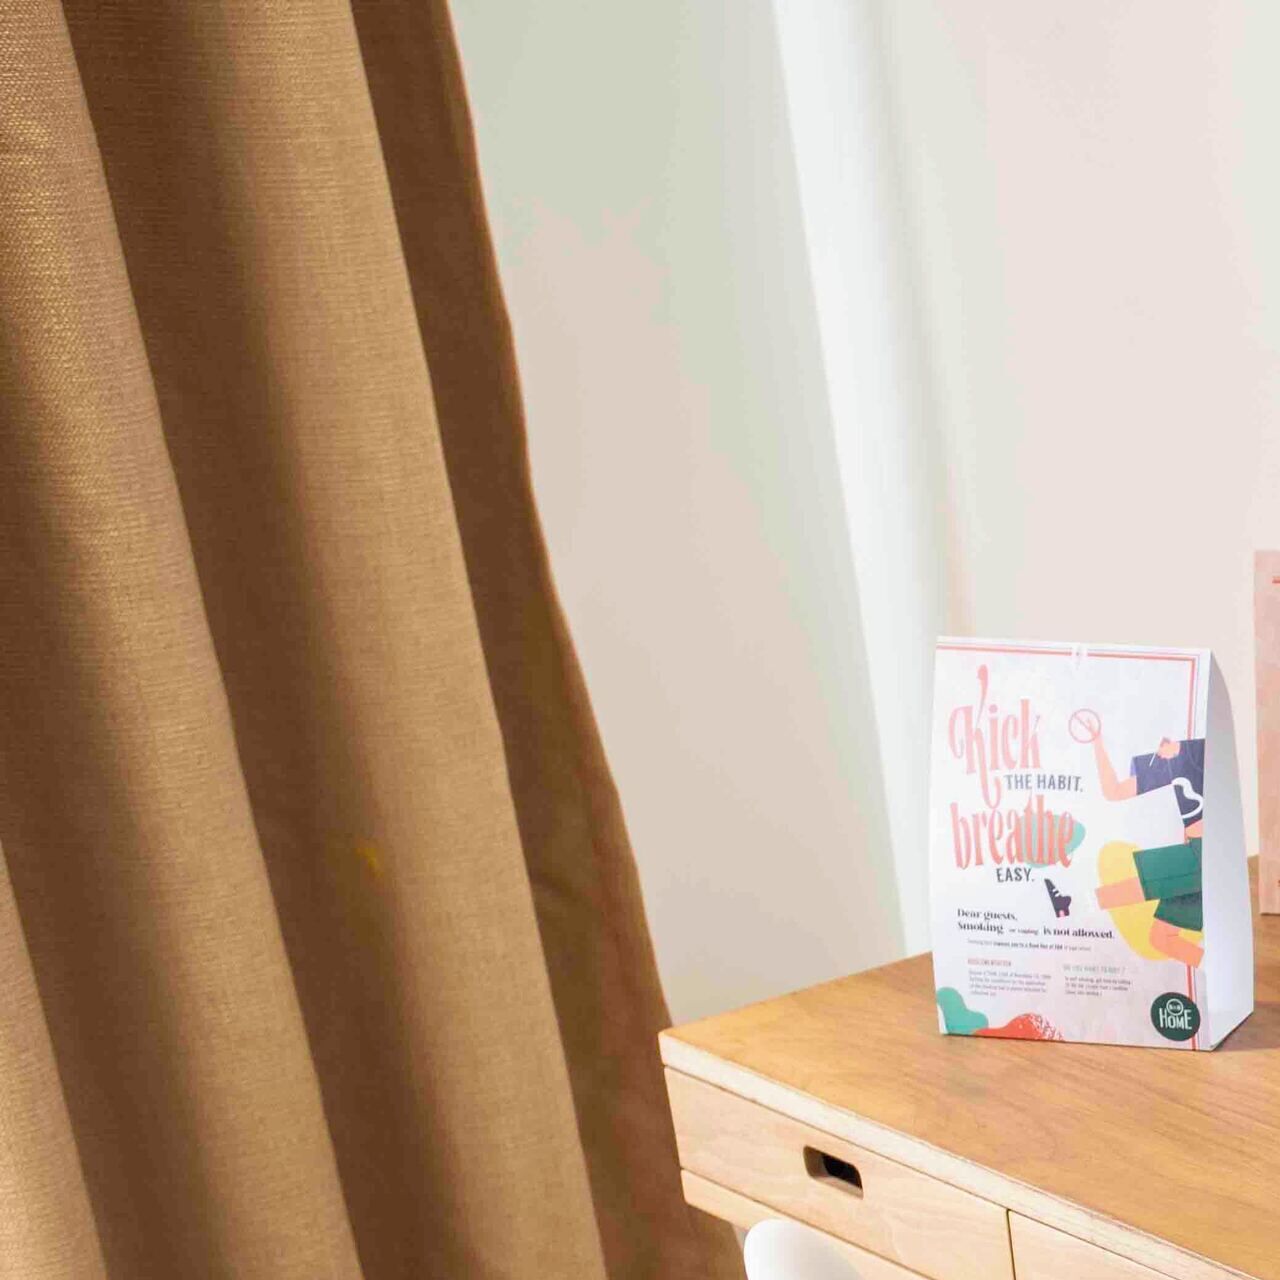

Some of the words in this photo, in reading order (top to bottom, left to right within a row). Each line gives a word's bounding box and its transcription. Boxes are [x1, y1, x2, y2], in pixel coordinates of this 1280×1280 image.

[1004, 773, 1032, 790] THE
[950, 794, 1075, 870] breathe
[957, 908, 982, 918] Dear
[1159, 1007, 1192, 1030] HOME
